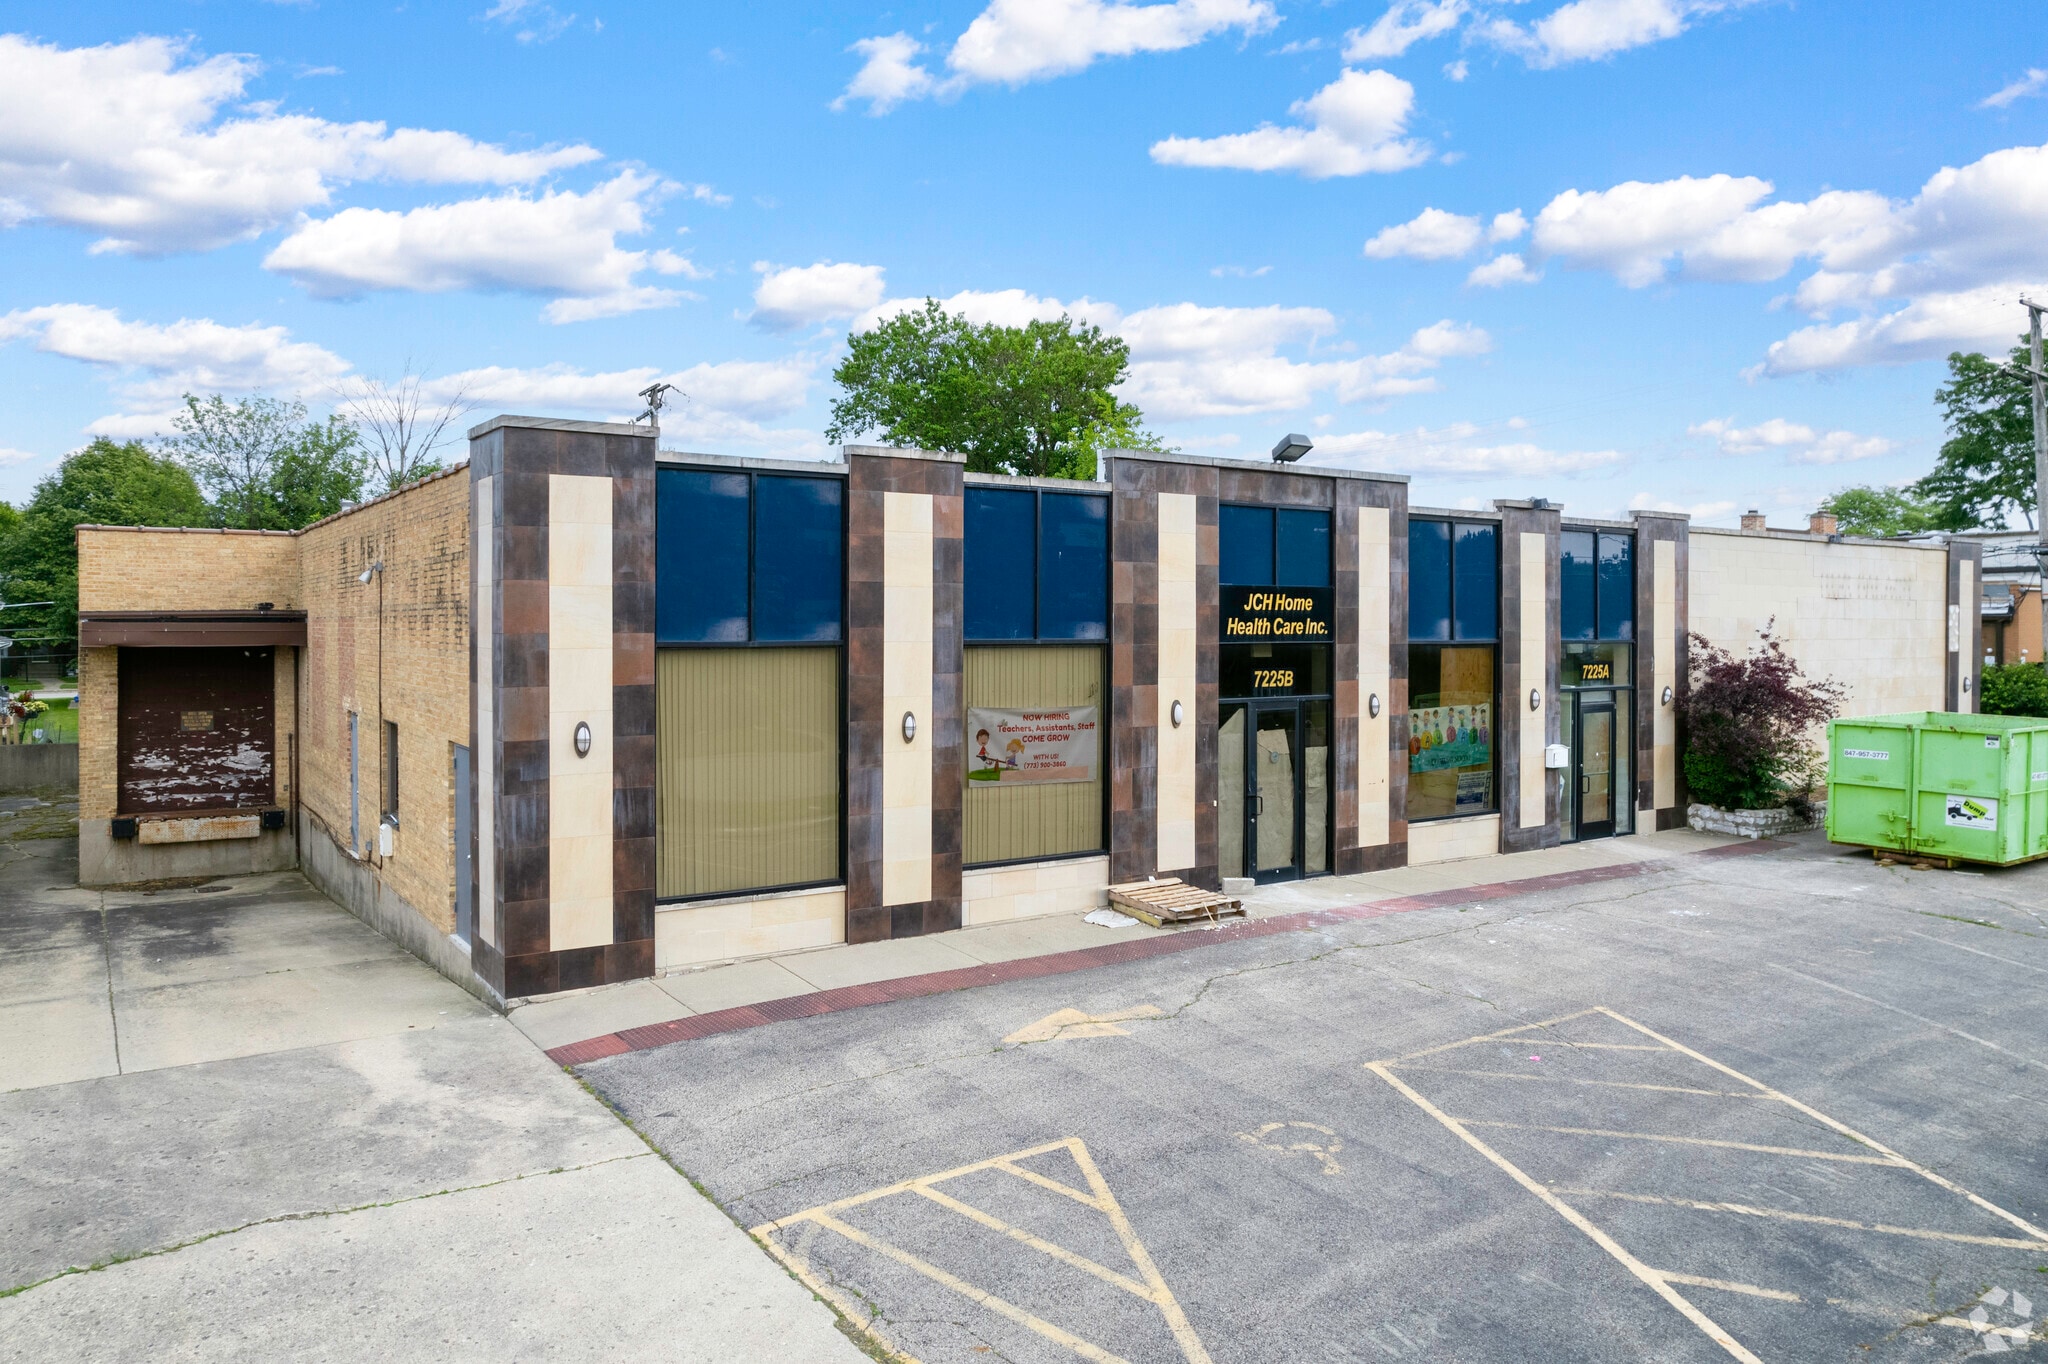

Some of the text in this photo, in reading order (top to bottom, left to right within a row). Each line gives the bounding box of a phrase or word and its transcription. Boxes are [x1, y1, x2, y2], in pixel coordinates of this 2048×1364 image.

[1244, 593, 1313, 611] JCH Home
[1227, 617, 1328, 635] Health Care Inc.
[1254, 670, 1294, 687] 7225B
[1583, 664, 1609, 679] 7225A
[997, 722, 1095, 733] Teachers, Assistants, Staff
[1022, 734, 1070, 743] COME GROW
[1963, 800, 1986, 817] Dump
